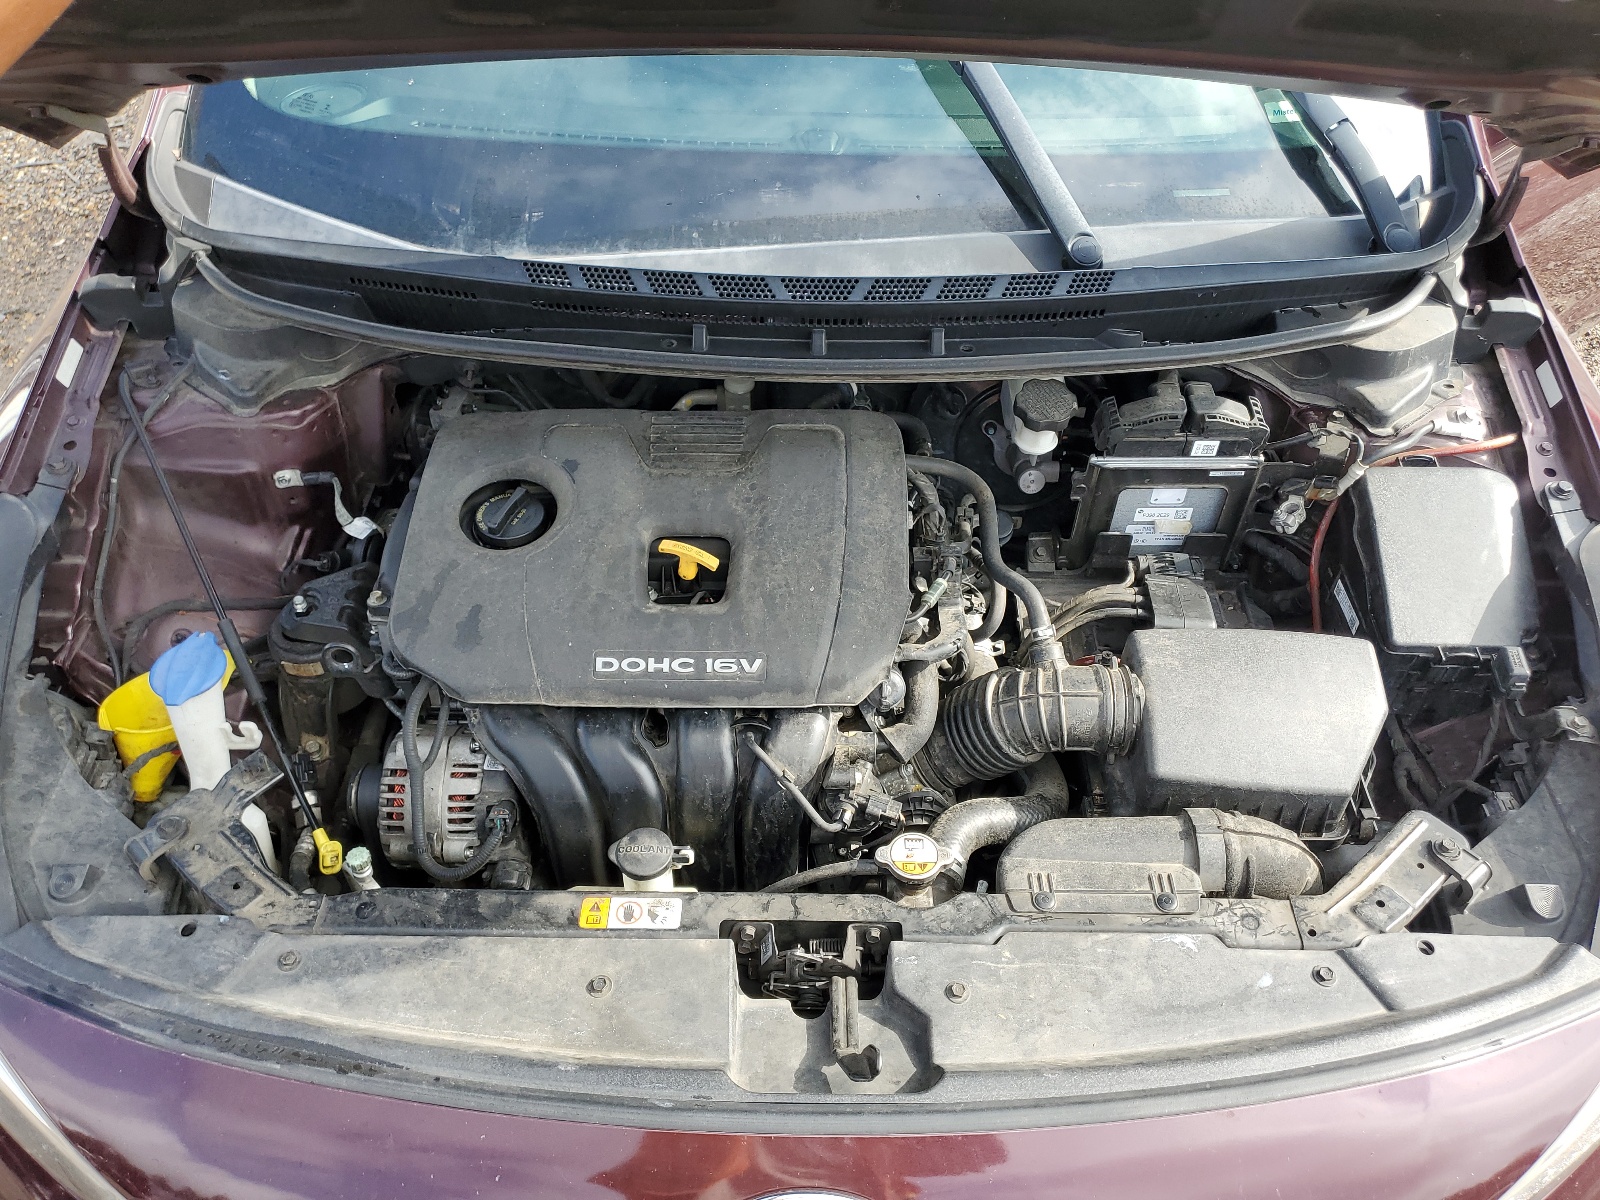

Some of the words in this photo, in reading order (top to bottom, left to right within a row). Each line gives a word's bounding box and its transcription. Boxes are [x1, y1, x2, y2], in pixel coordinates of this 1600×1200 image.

[1272, 109, 1296, 117] Miste
[489, 493, 512, 502] MANUA
[595, 657, 695, 673] DOHC
[705, 658, 763, 674] 16V
[618, 844, 671, 855] COOLANT
